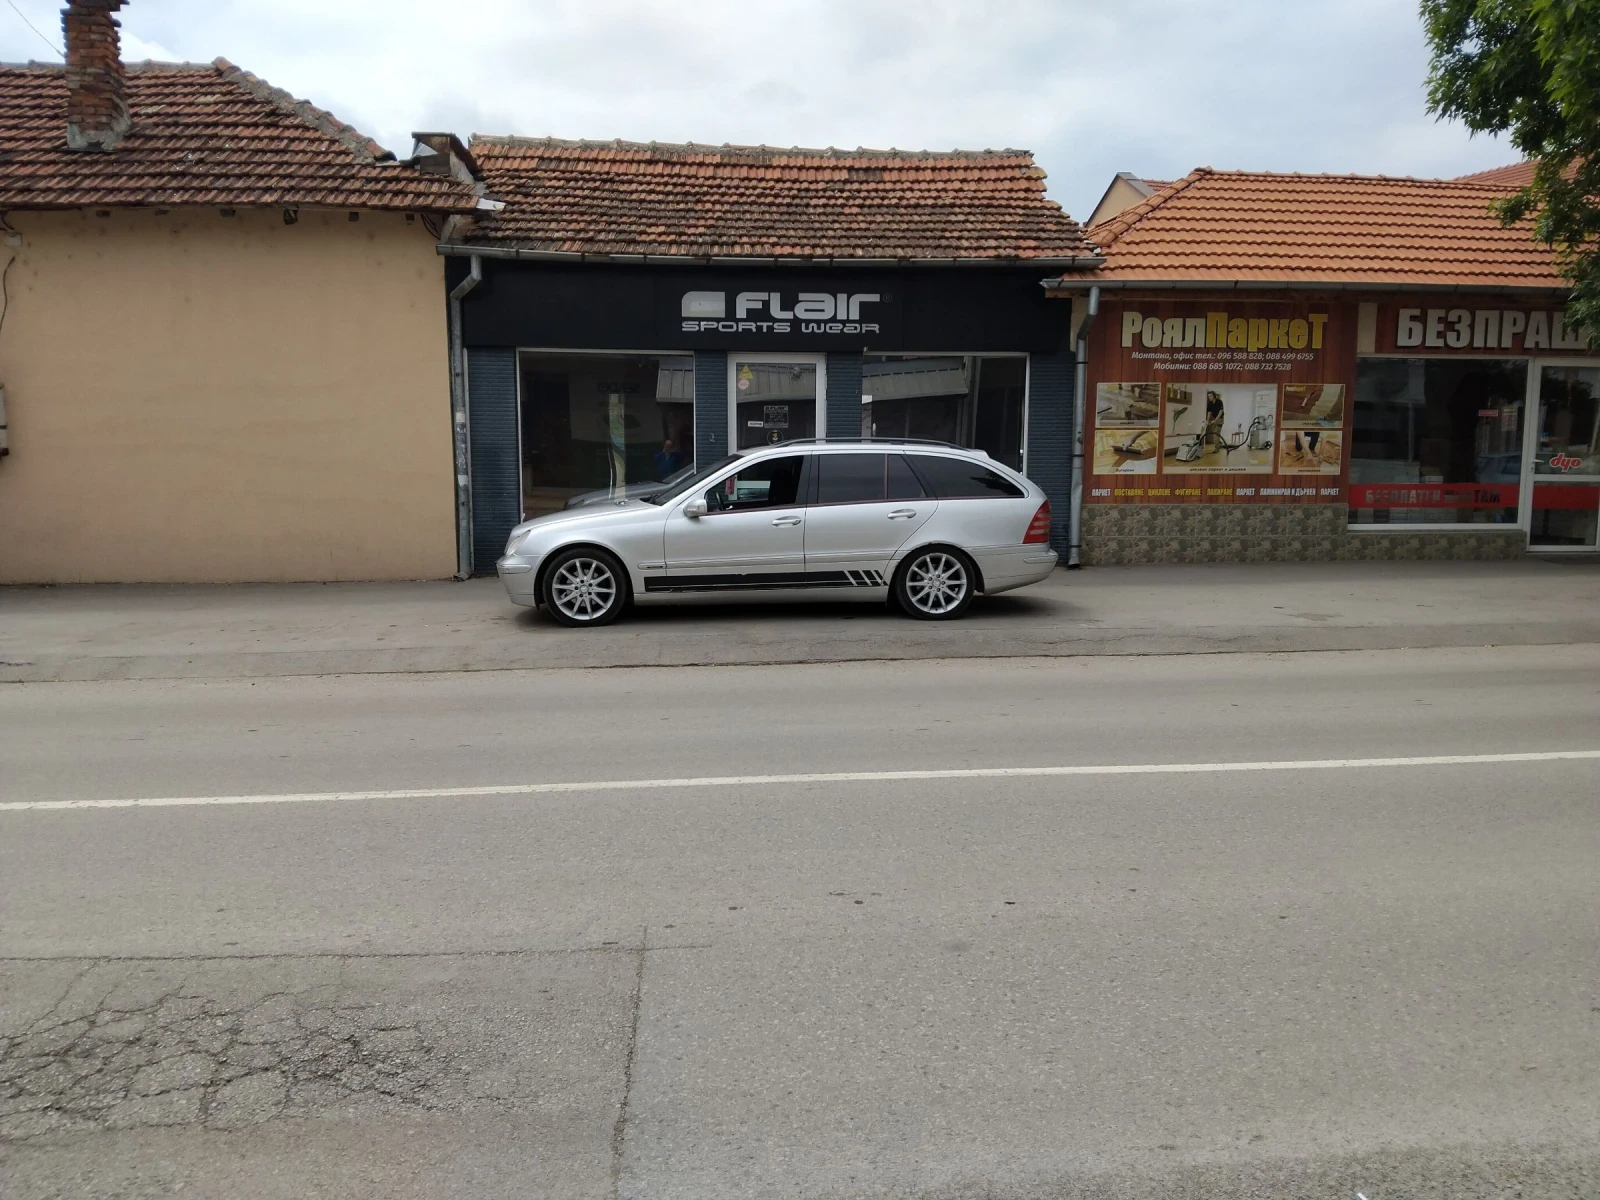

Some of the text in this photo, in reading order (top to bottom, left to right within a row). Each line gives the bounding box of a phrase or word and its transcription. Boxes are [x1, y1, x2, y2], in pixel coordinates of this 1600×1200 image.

[682, 321, 791, 333] SPORTS
[1131, 352, 1315, 361] Монтана, офис тел.: 096 588 828; 088 499 6755
[1153, 361, 1292, 371] Мобилни: 088 685 1072; 088 732 7528
[1550, 453, 1582, 472] dyo
[1236, 488, 1255, 497] ПАРКЕТ
[1320, 488, 1339, 497] ПАРКЕТ
